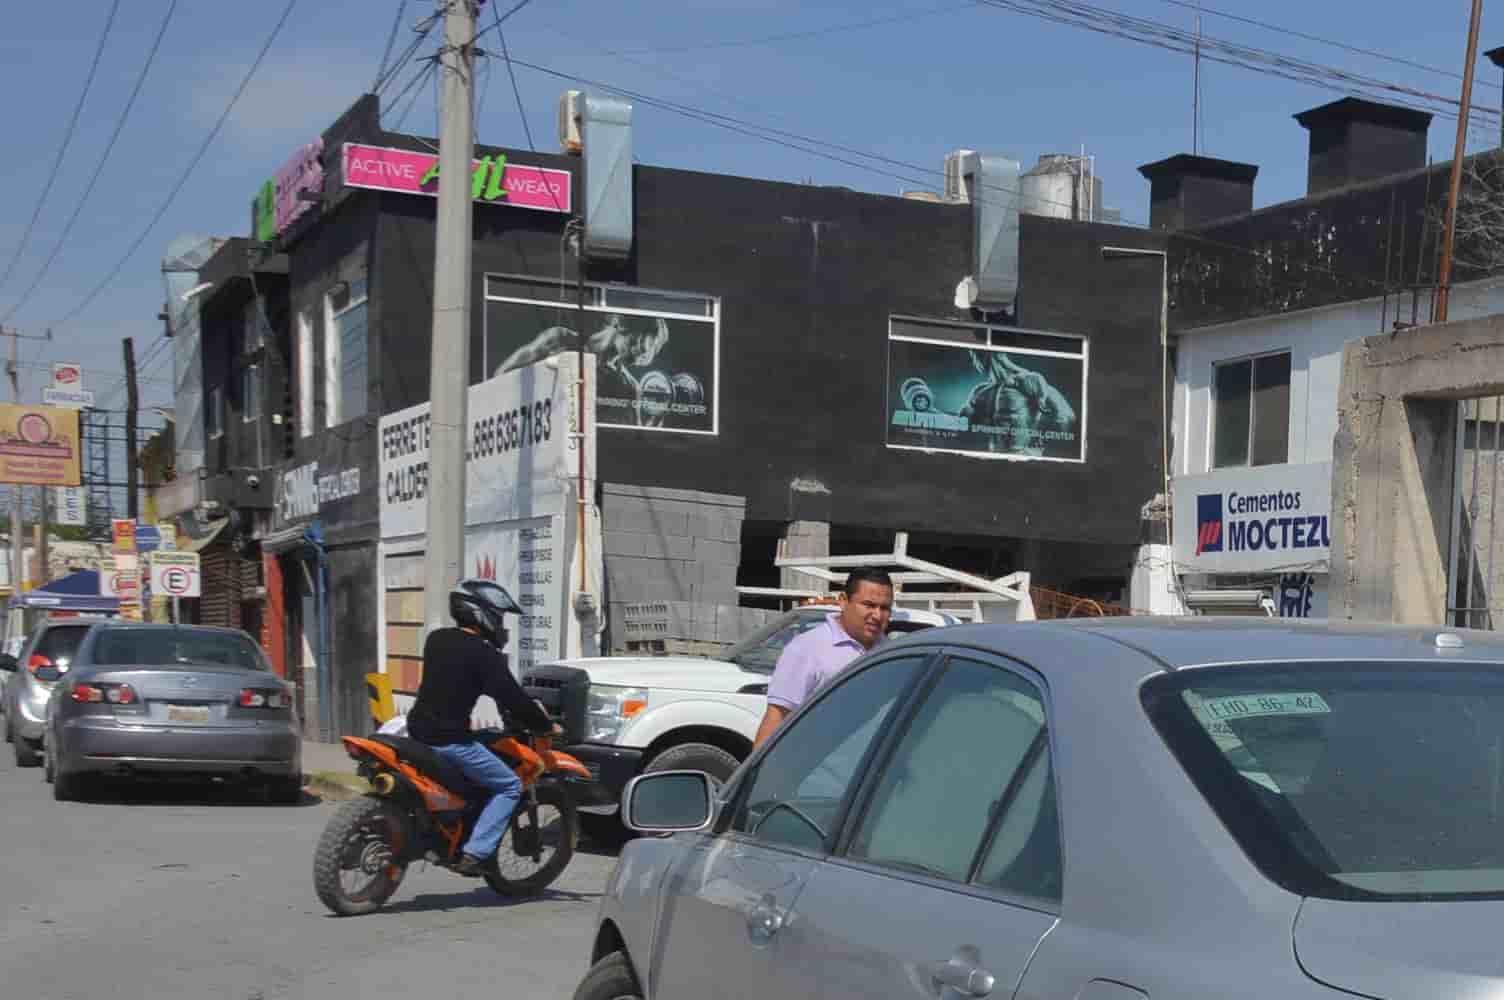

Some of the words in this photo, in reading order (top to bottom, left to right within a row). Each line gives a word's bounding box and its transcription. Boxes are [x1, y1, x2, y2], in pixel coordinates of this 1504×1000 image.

[350, 158, 417, 179] ACTIVE
[506, 177, 561, 196] WEAR
[1228, 490, 1301, 514] Cementos
[168, 571, 185, 589] E
